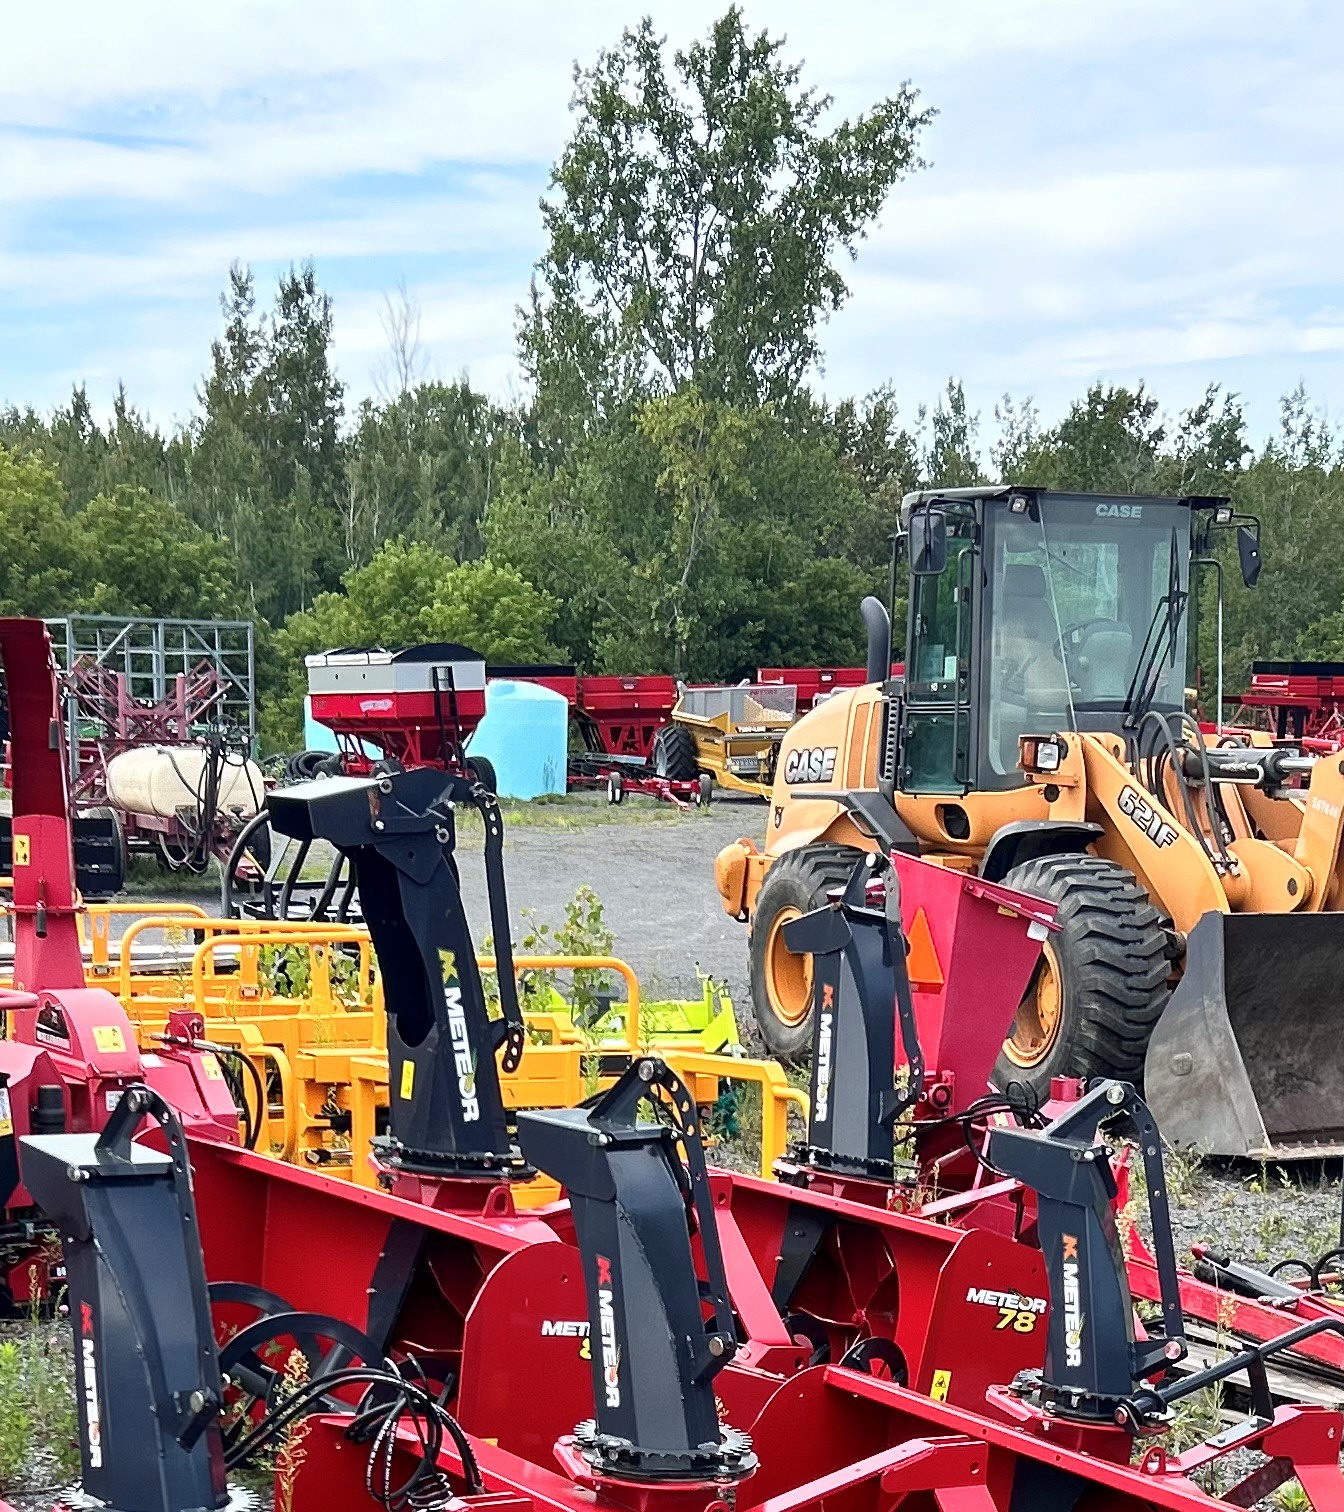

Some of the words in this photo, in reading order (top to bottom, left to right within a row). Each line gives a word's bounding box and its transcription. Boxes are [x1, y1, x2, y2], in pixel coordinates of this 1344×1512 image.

[1096, 504, 1142, 518] CASE
[785, 746, 838, 784] CASE
[1118, 784, 1180, 849] 621F
[444, 986, 480, 1123] METEOR
[814, 1013, 833, 1122] METEOR
[966, 1287, 1048, 1314] METEOR
[995, 1307, 1037, 1333] 78
[1063, 1263, 1082, 1367] METEOR
[598, 1289, 621, 1408] METEOR
